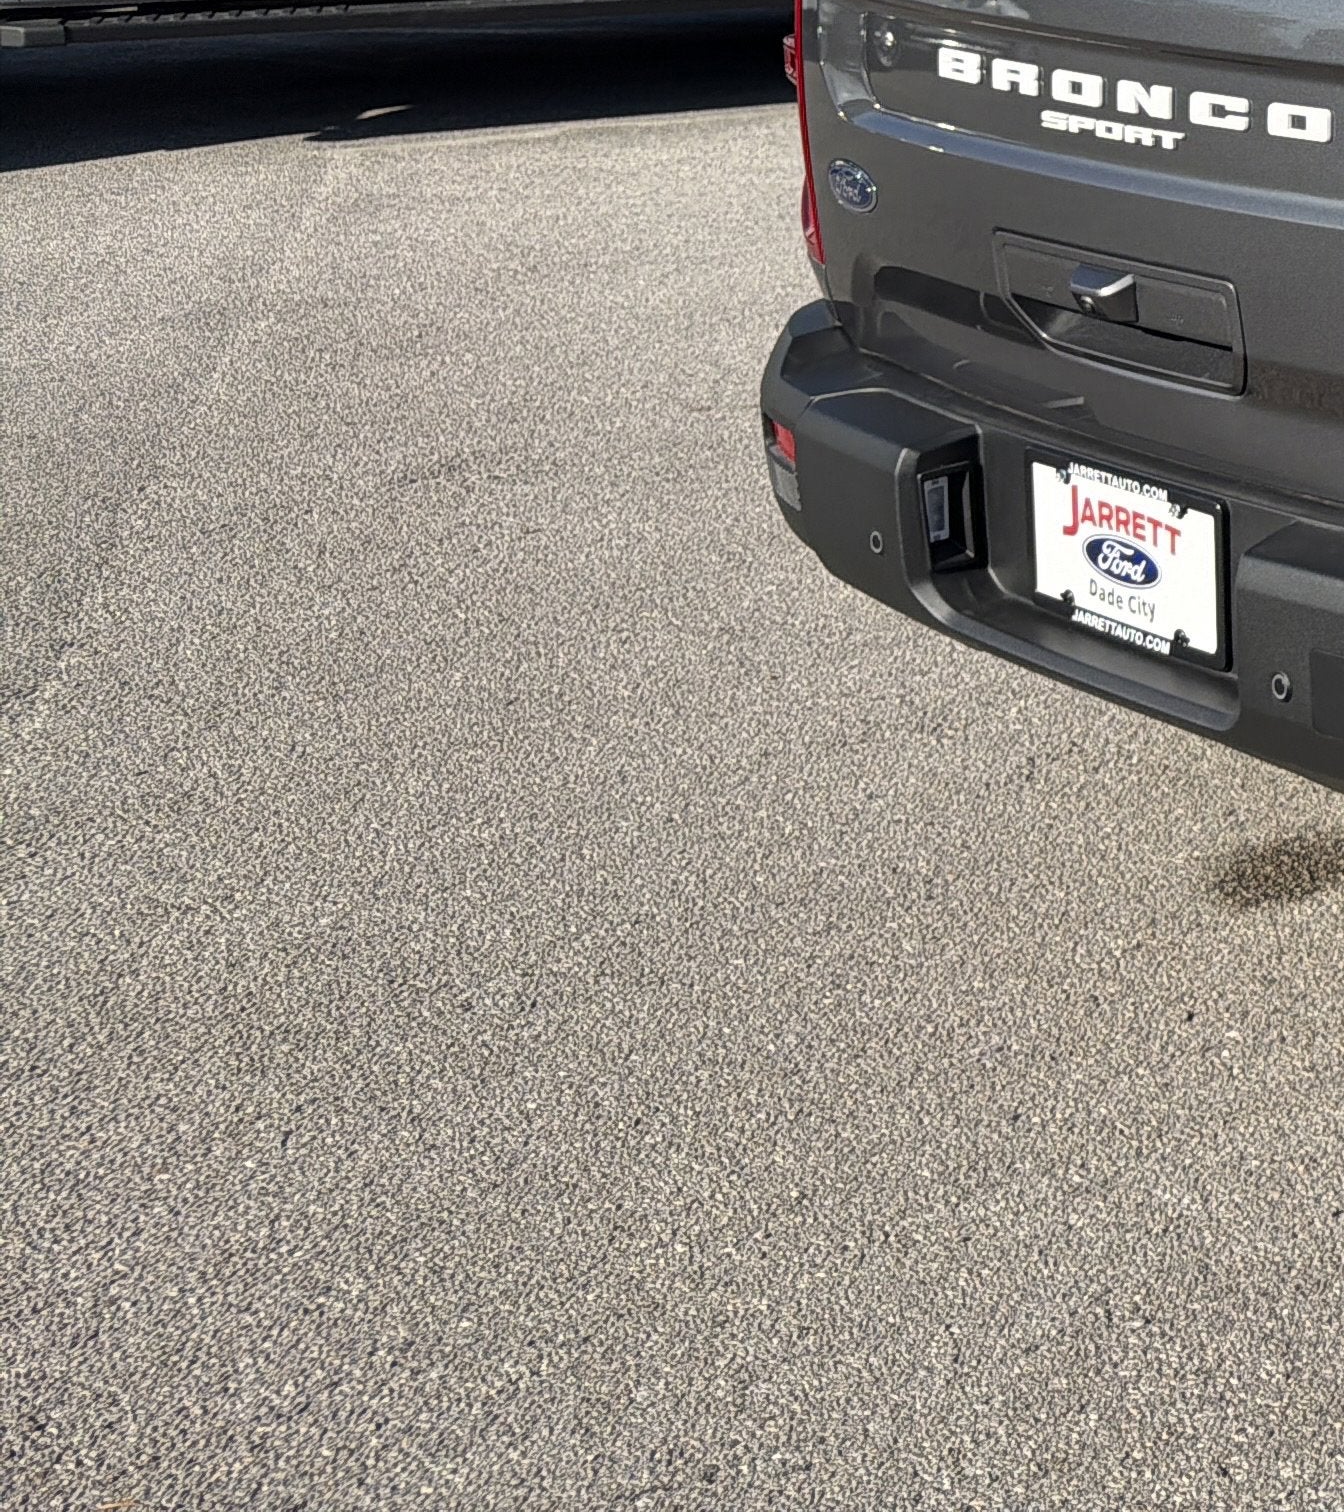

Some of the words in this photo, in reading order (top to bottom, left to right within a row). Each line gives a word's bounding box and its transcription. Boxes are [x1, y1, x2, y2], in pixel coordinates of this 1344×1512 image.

[937, 46, 1333, 143] BRONCO
[1040, 109, 1186, 150] SPORT
[1067, 461, 1168, 503] JARRETTAUTO.COM
[1062, 484, 1182, 556] JARRETT
[1097, 540, 1146, 583] Ford
[1089, 578, 1124, 611] Dade
[1127, 595, 1156, 623] City
[1071, 609, 1171, 656] JARRETTAUTO.COM
